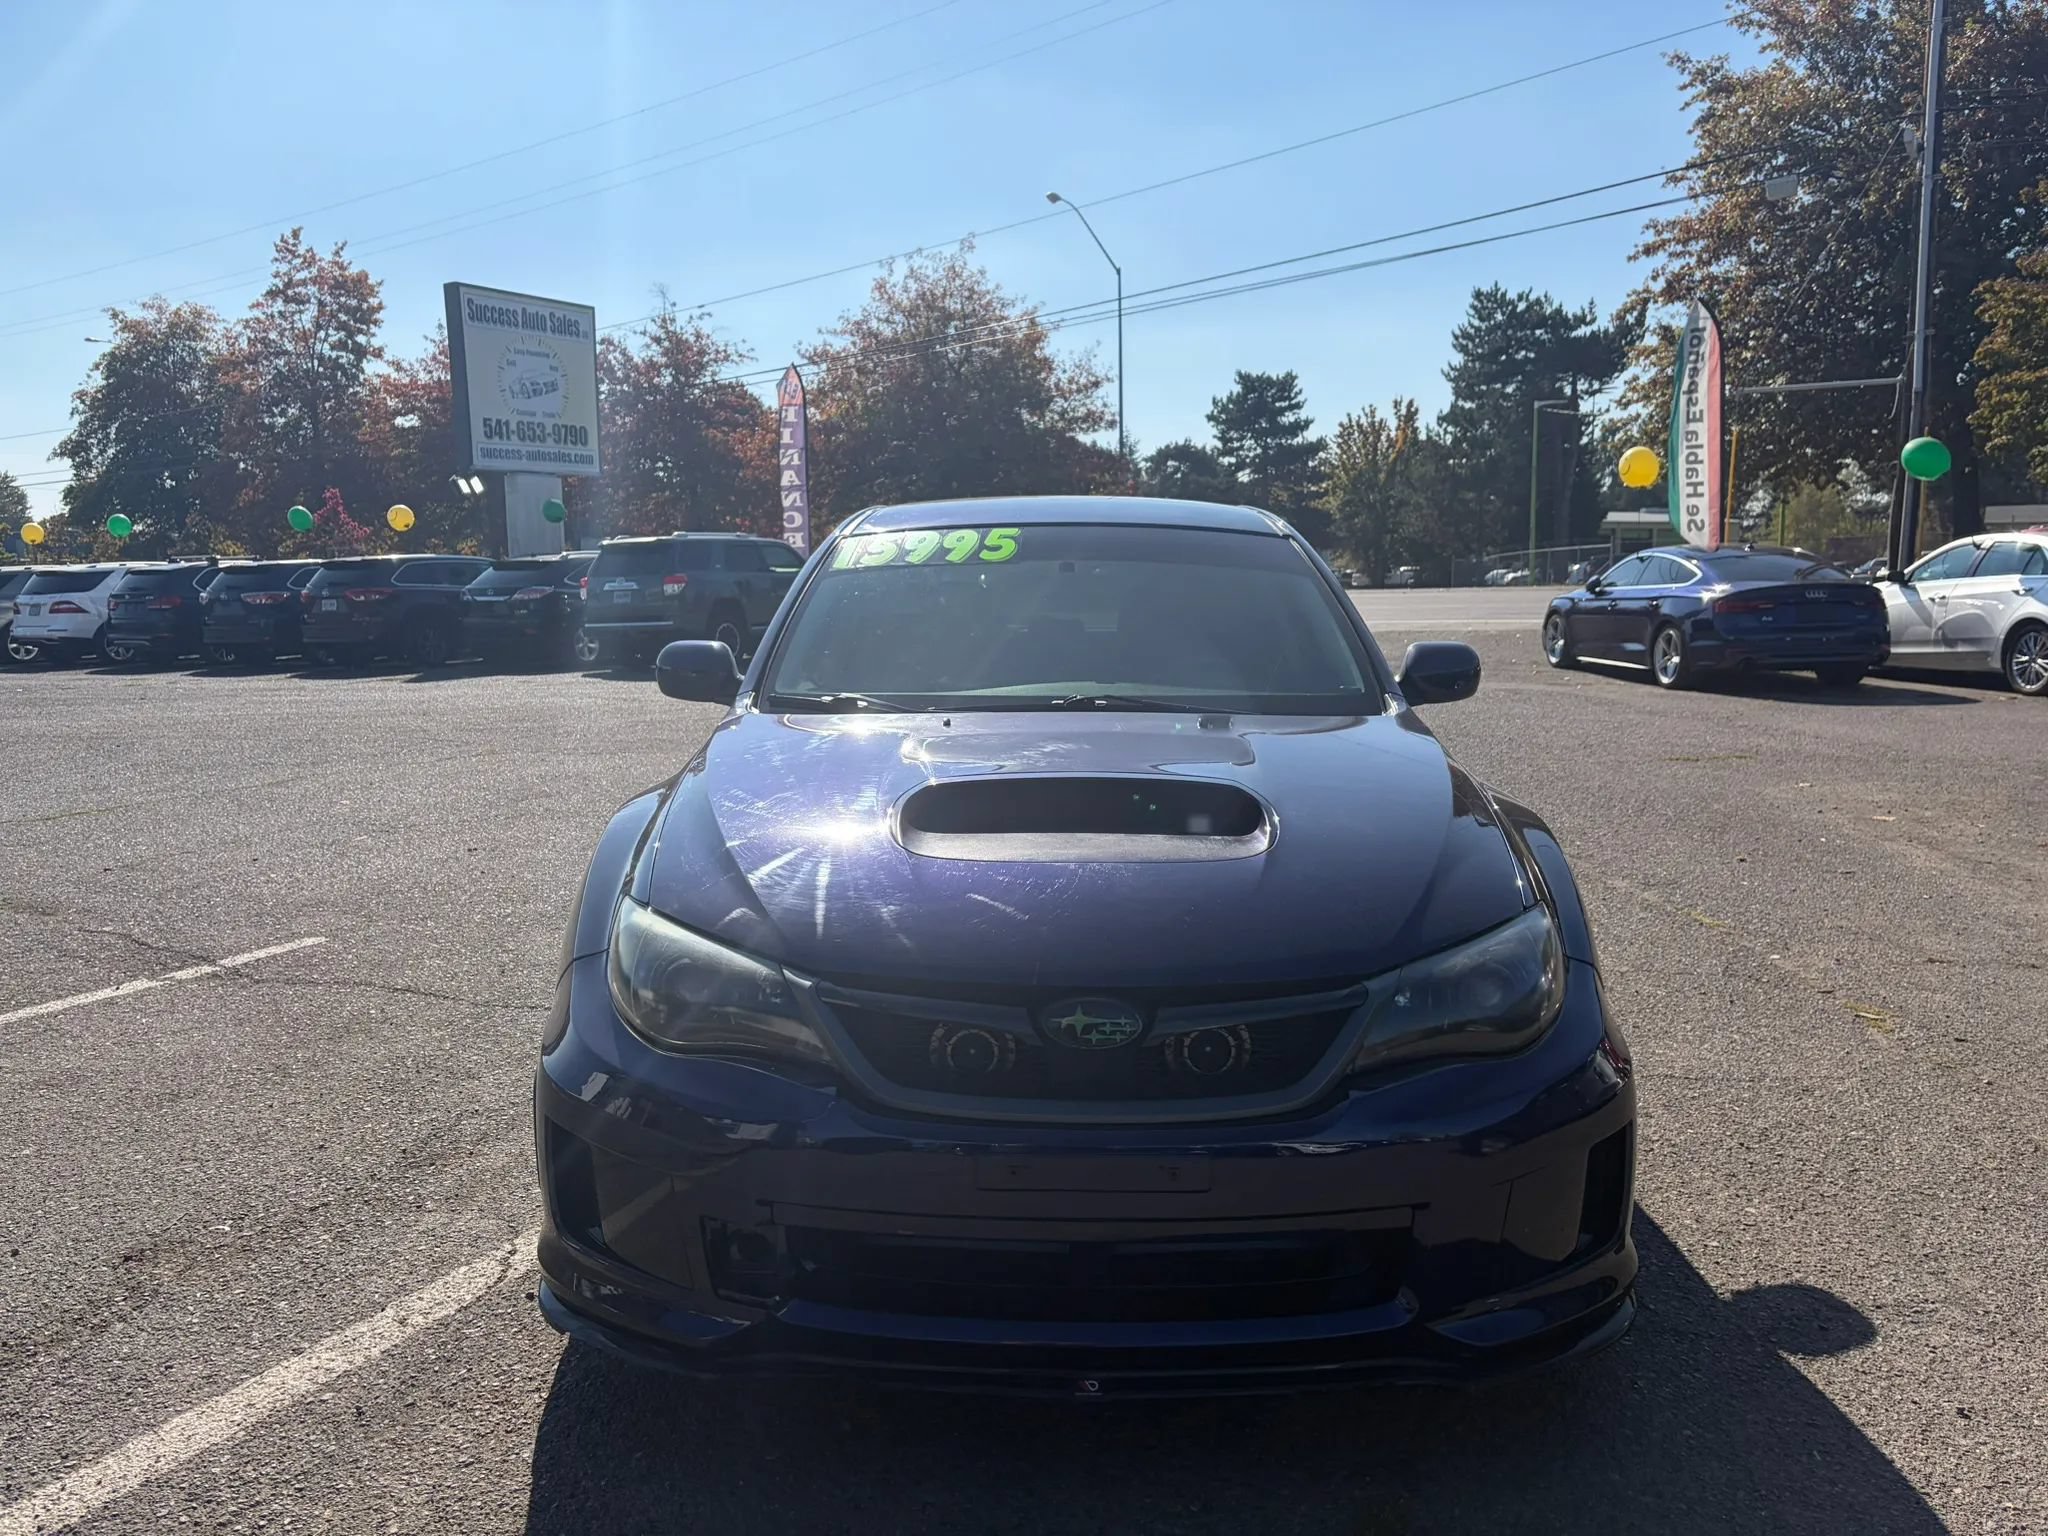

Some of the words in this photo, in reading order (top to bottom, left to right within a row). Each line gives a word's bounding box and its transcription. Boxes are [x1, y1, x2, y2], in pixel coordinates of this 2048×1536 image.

[467, 297, 520, 330] Success
[521, 306, 548, 334] Auto
[548, 311, 580, 339] Sales
[482, 415, 589, 448] 541-653-9790
[479, 446, 594, 465] success-autosales.com
[832, 527, 1022, 570] 15995
